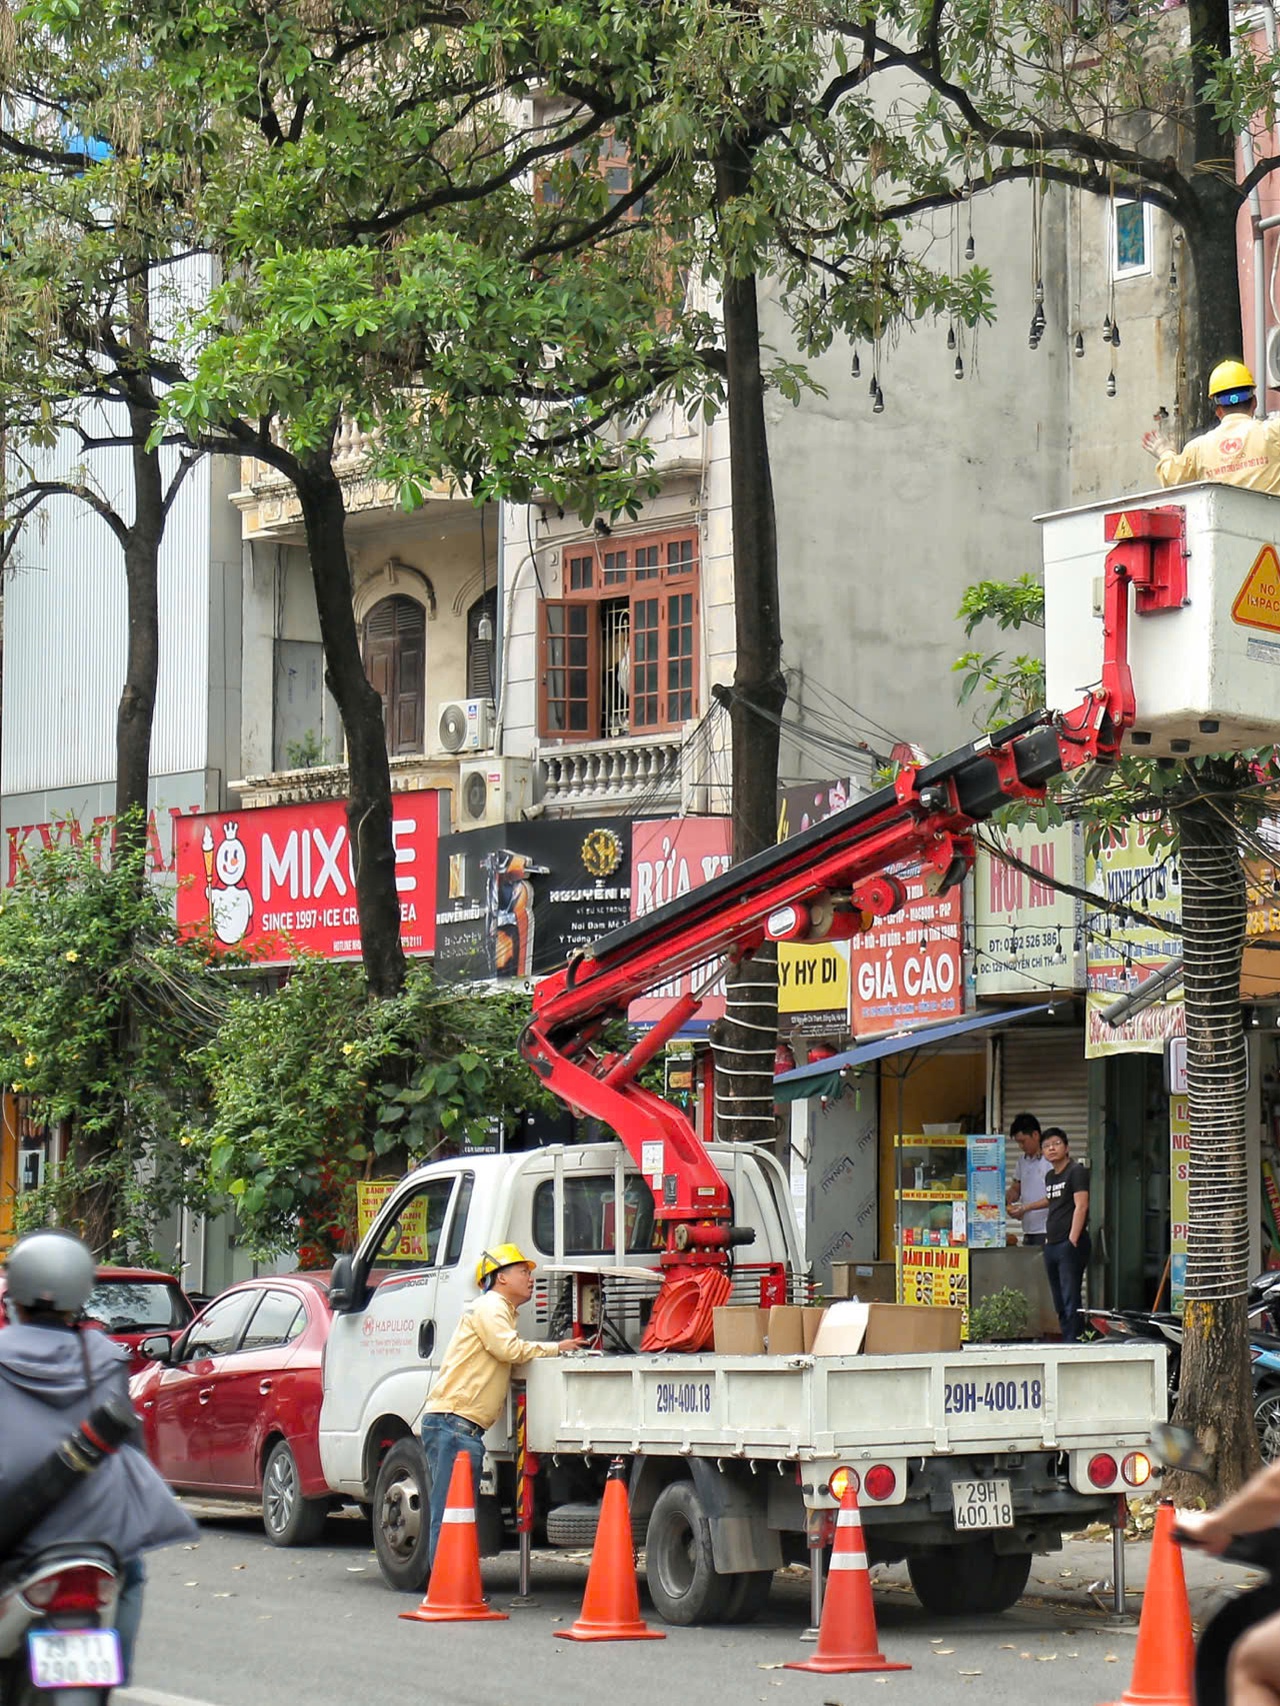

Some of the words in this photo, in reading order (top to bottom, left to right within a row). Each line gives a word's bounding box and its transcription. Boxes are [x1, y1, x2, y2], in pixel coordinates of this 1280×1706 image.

[1259, 583, 1276, 596] NO
[261, 817, 417, 902] MIXE
[990, 837, 1024, 924] HỘI
[1029, 841, 1056, 909] AN
[262, 913, 293, 932] SINCE
[295, 909, 317, 929] 1997
[323, 907, 342, 927] ICE
[989, 938, 1003, 954] ĐT:
[1026, 934, 1040, 949] 526
[1042, 931, 1058, 947] 386
[795, 959, 817, 986] HY
[822, 957, 837, 984] DI
[857, 947, 899, 1001] GIÁ
[903, 952, 955, 997] CAO
[375, 1319, 415, 1333] HAPULICO
[656, 1383, 711, 1415] 29H-400.18
[944, 1379, 1042, 1415] 29H-400.18
[966, 1481, 998, 1504] 29H
[957, 1505, 1012, 1528] 400.18
